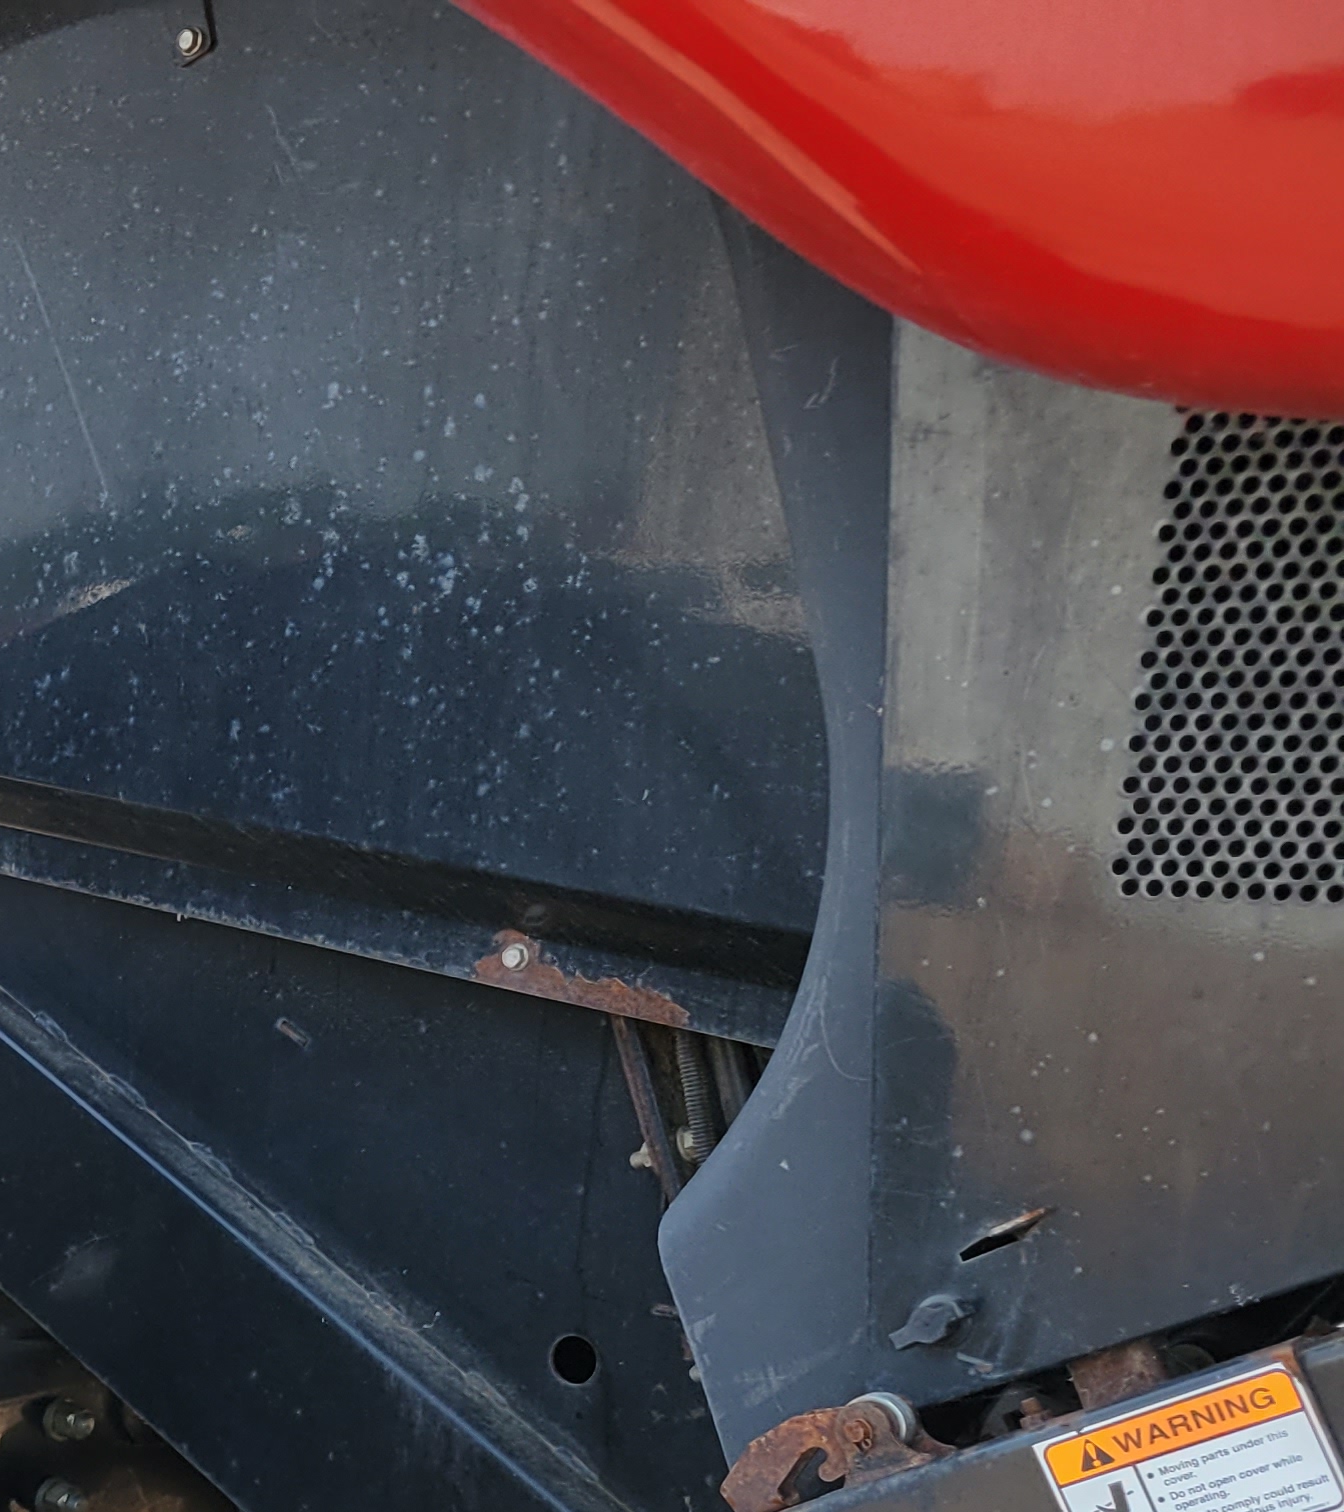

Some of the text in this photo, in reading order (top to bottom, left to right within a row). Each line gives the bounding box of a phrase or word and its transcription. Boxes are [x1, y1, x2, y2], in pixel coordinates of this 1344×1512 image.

[1111, 1387, 1277, 1453] WARNING
[1158, 1429, 1289, 1476] Moving parts under this
[1163, 1471, 1197, 1487] cover.
[1168, 1454, 1303, 1502] Do not open cover while
[1263, 1484, 1295, 1501] could
[1296, 1474, 1330, 1491] result
[1174, 1490, 1230, 1512] operating.
